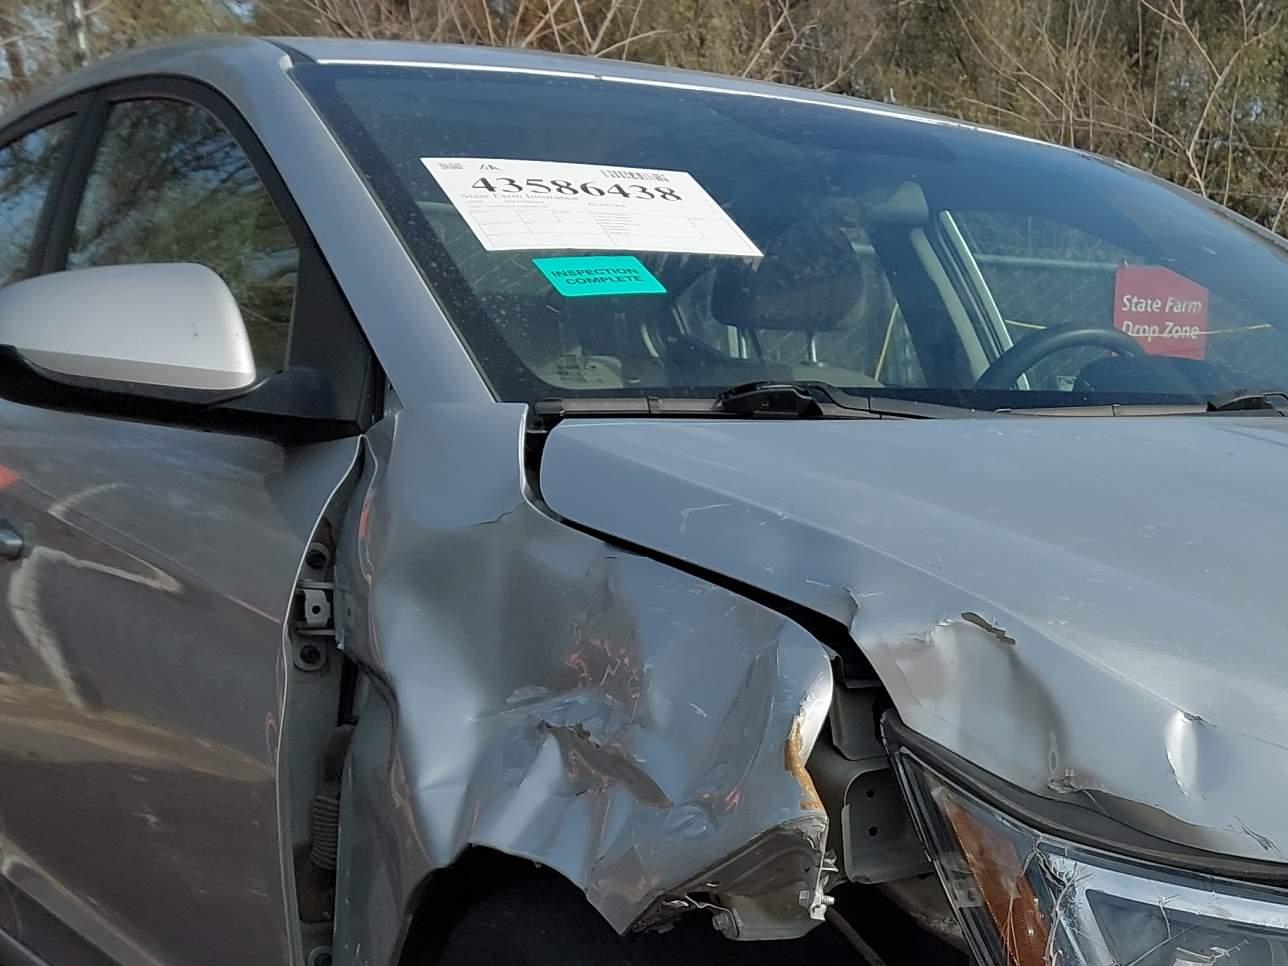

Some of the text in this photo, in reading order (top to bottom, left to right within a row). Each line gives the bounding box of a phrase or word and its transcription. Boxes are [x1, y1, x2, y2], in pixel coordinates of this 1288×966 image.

[472, 176, 682, 201] 43586438
[550, 268, 639, 278] INSPECTION
[566, 275, 643, 285] COMPLETE
[1122, 295, 1202, 313] State Farm
[1121, 320, 1200, 342] Drop Zone
